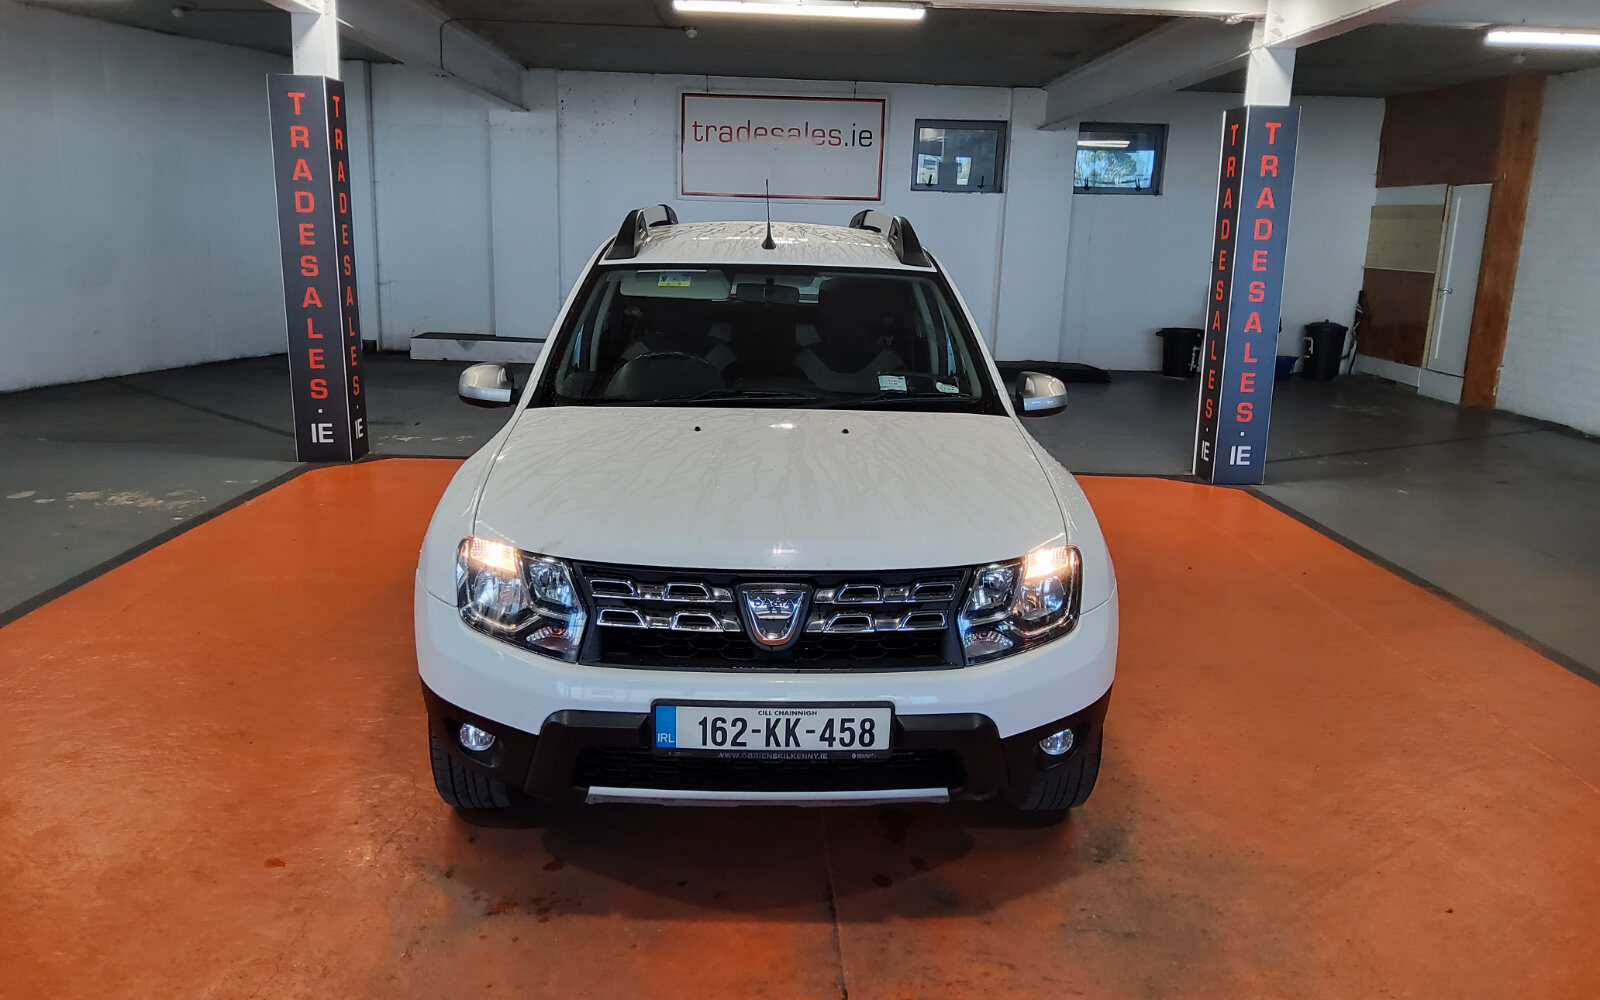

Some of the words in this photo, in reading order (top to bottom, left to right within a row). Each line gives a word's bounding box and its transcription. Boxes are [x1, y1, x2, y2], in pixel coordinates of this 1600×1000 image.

[692, 119, 873, 147] tradesales.ie
[657, 732, 675, 743] IRL
[698, 716, 876, 748] 162-KK-458
